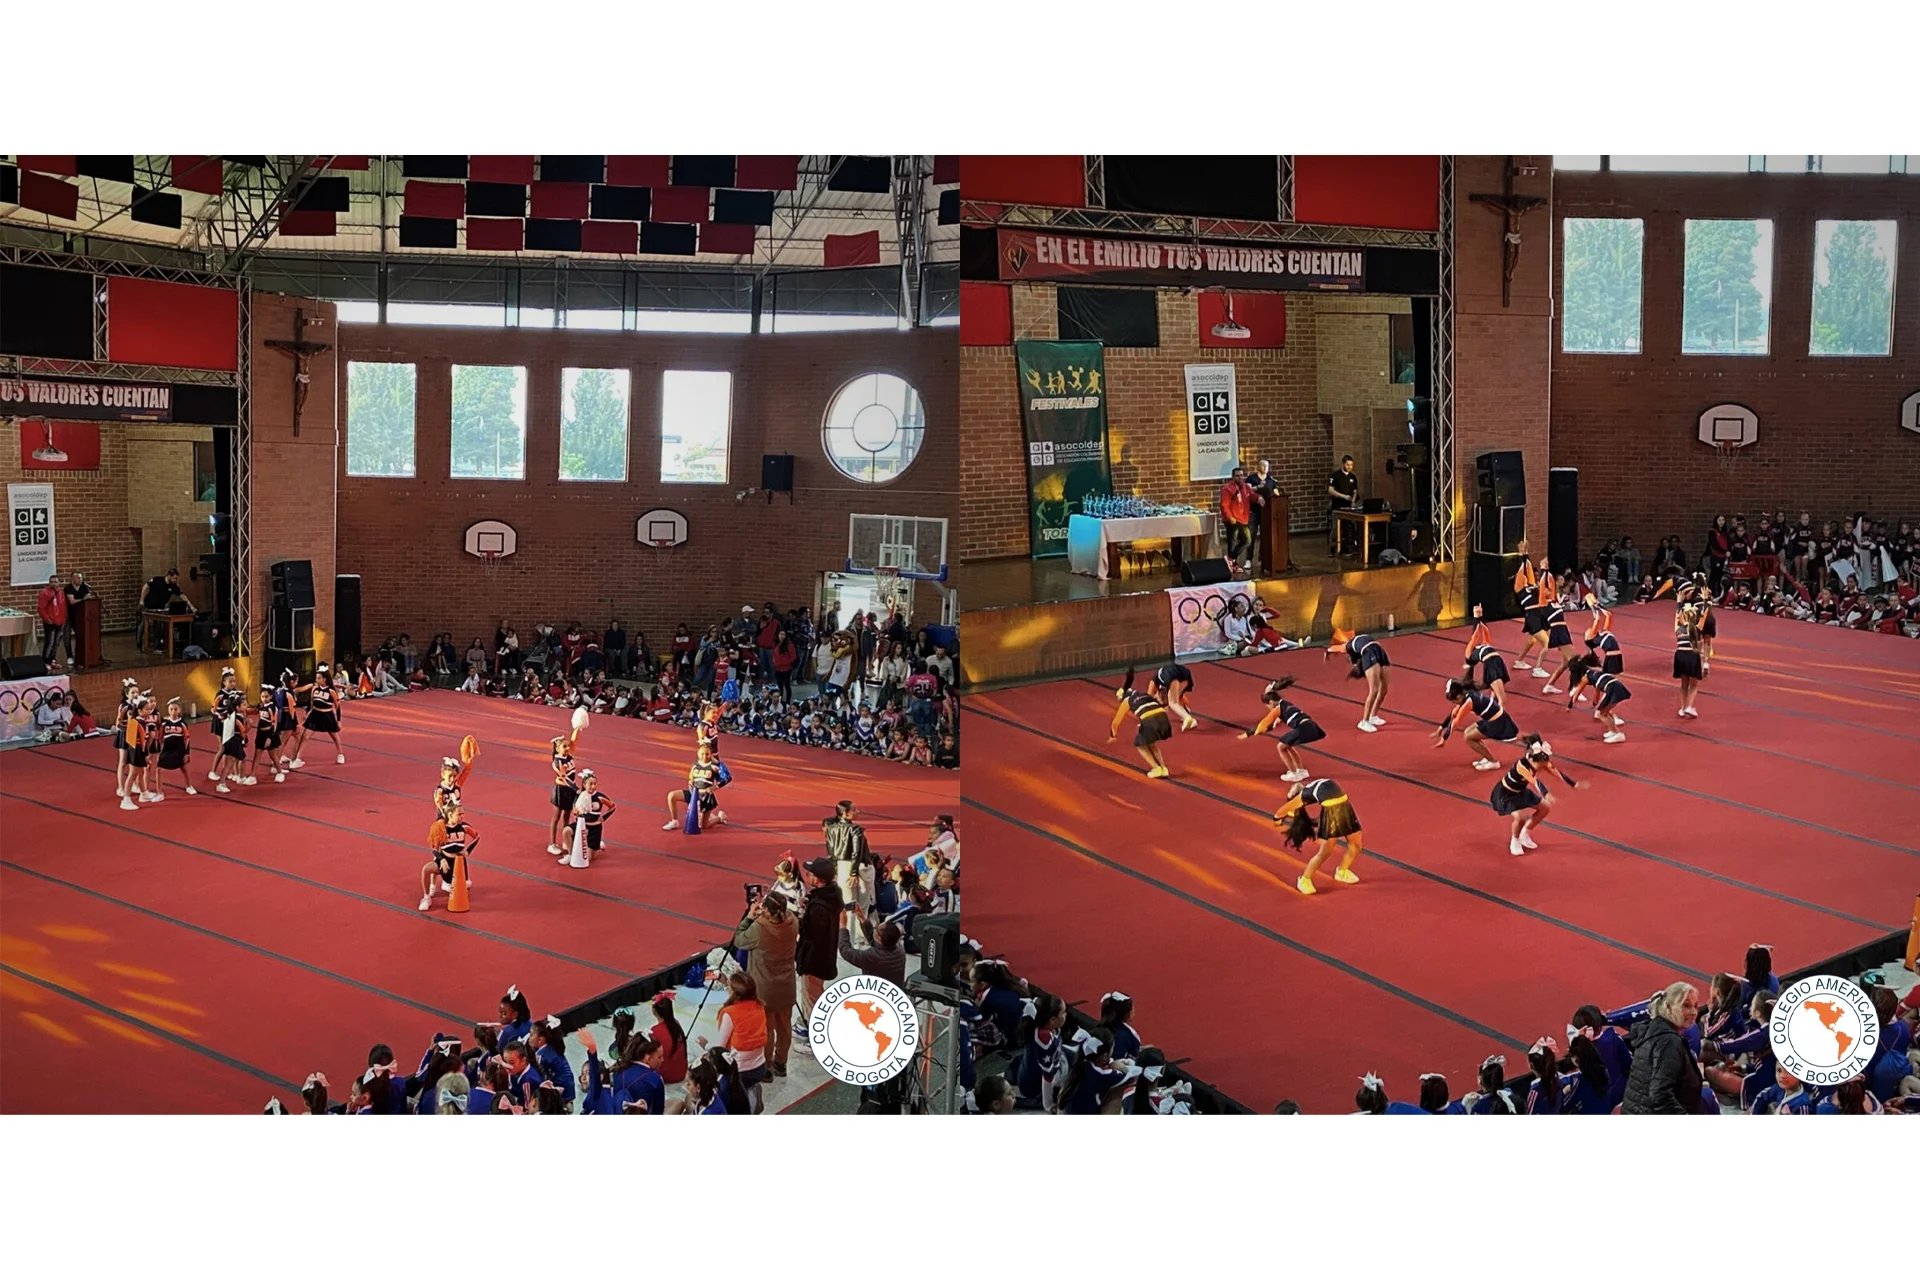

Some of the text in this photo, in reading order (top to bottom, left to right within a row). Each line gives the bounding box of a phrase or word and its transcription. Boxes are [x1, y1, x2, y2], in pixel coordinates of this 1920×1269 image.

[1035, 236, 1063, 264] EN
[1067, 239, 1089, 265] EL
[1093, 240, 1160, 269] EMILIO
[1164, 246, 1201, 270] TUS
[1206, 248, 1284, 274] VALORES
[1288, 251, 1362, 276] CUENTAN
[28, 383, 99, 406] VALORES
[102, 386, 169, 409] CUENTAN
[1030, 396, 1099, 410] FESTIVALES
[1054, 440, 1104, 450] asocoldep
